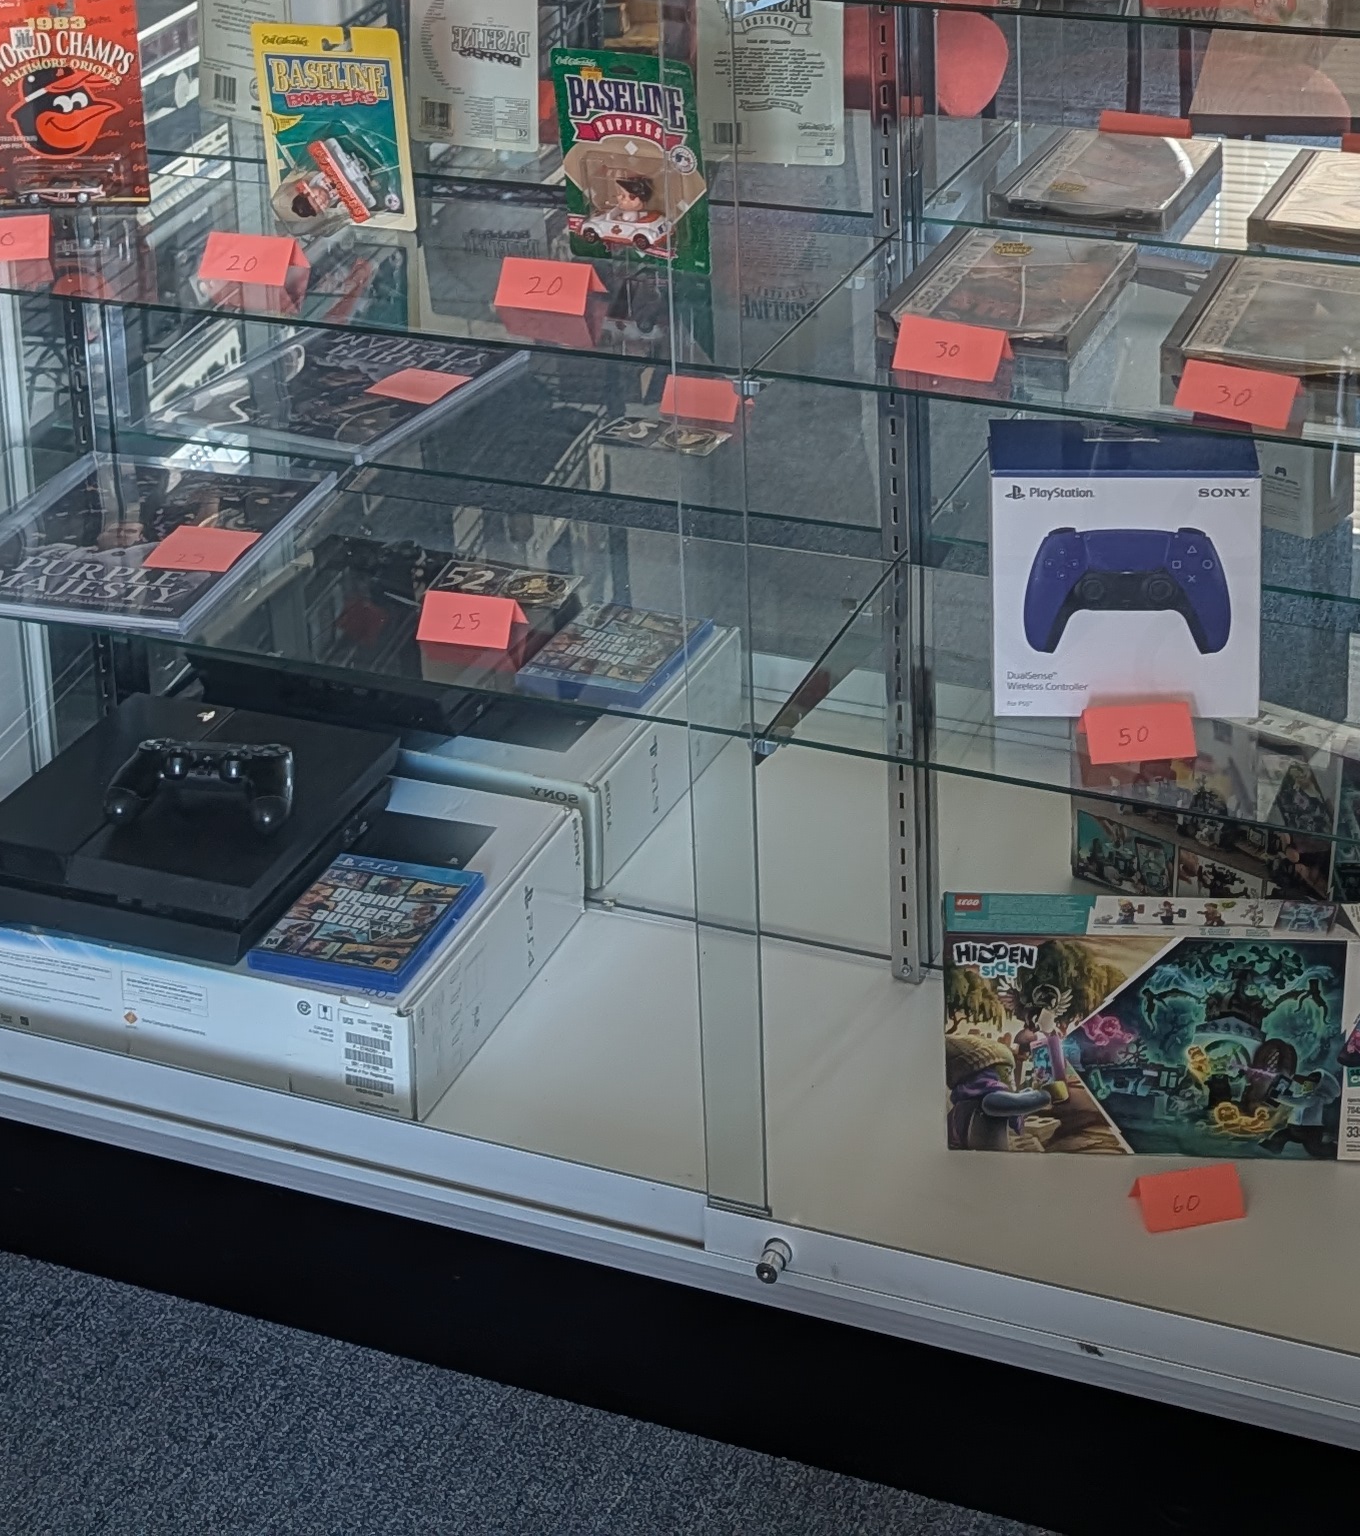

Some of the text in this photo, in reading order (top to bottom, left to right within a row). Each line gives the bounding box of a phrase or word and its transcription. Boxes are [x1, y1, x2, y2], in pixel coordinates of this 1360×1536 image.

[23, 16, 86, 30] 1983
[55, 29, 135, 76] CHAMPS
[1, 58, 123, 88] BALTIMORE ORIOLES
[268, 57, 388, 98] BASELINE
[285, 90, 379, 108] BOPPERS
[565, 74, 685, 130] BASELINE
[595, 115, 663, 140] BOPPERS
[225, 255, 258, 273] 20
[523, 275, 563, 296] 20
[935, 340, 961, 359] 30
[1216, 385, 1253, 407] 30
[1029, 487, 1250, 501] PlayStation SONY
[15, 553, 191, 589] PURPLE
[445, 566, 496, 592] 52
[451, 613, 481, 631] 25
[1006, 682, 1089, 692] Wireless Controller
[1118, 726, 1150, 747] 50
[357, 859, 398, 875] PS4
[328, 886, 405, 910] grand
[956, 898, 980, 907] LEGO
[311, 906, 369, 931] auto
[334, 898, 405, 922] theft
[952, 943, 1039, 969] HIDDEN
[980, 963, 1016, 979] SIDE
[1171, 1193, 1201, 1214] 60
